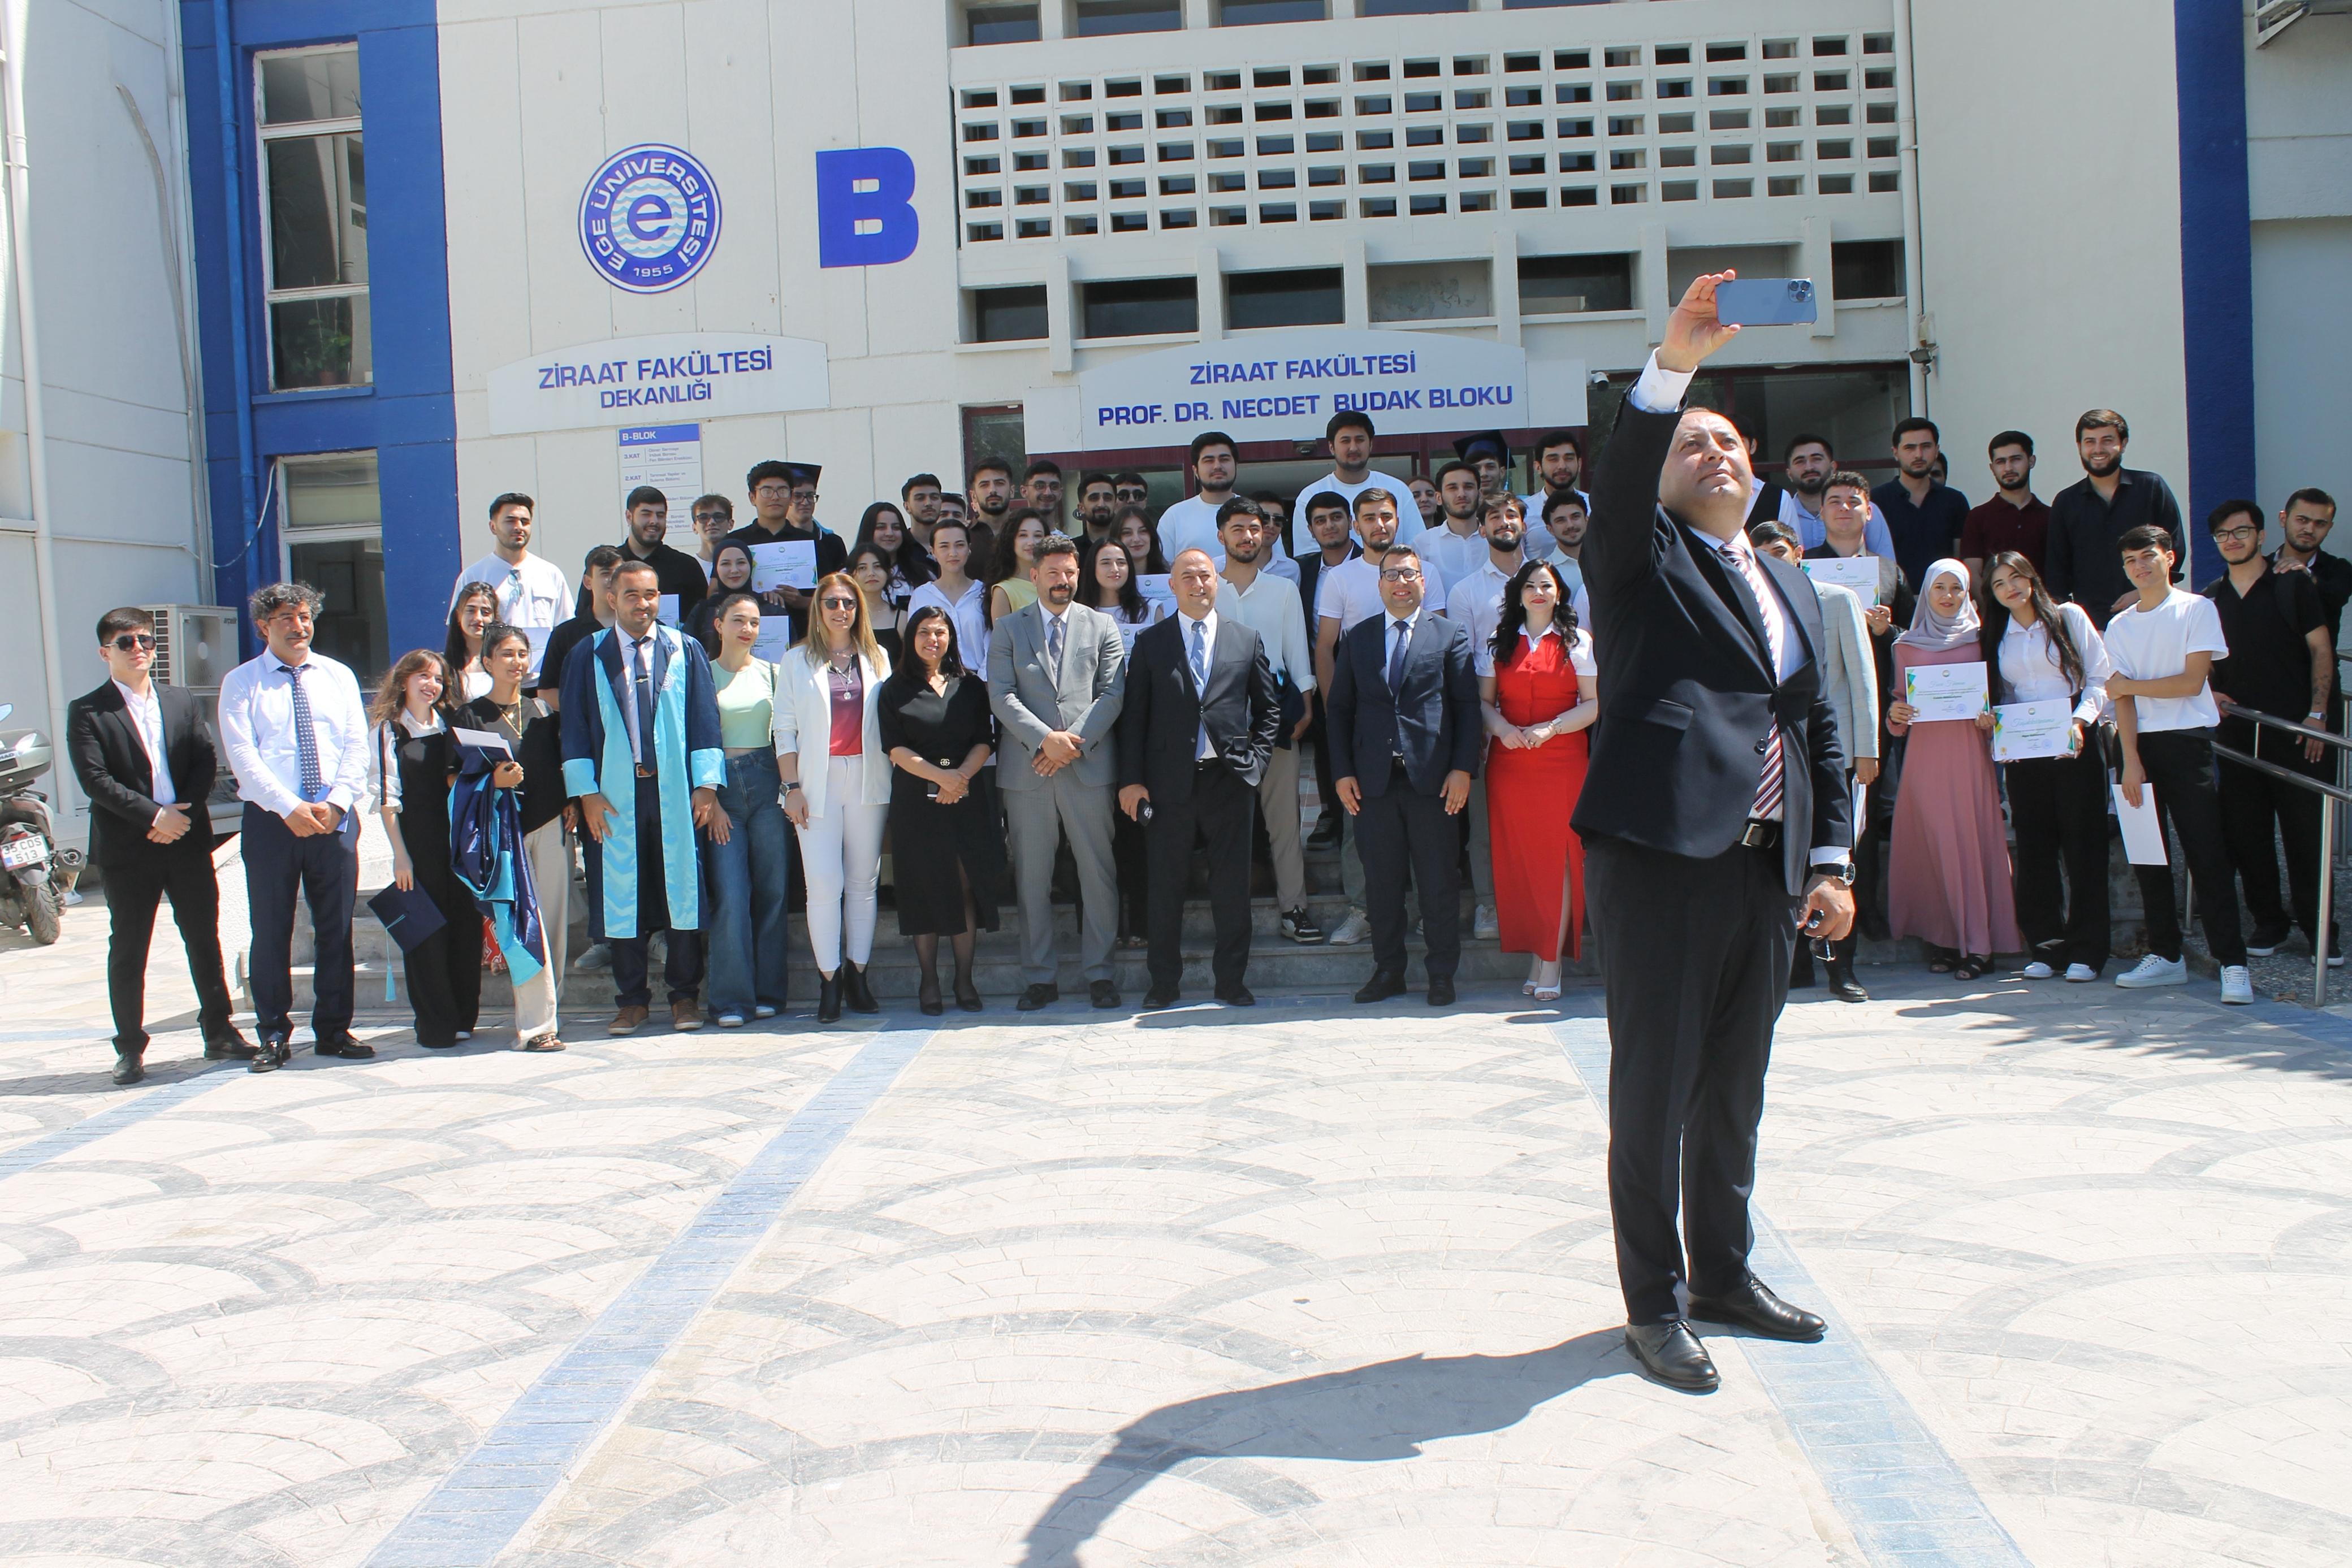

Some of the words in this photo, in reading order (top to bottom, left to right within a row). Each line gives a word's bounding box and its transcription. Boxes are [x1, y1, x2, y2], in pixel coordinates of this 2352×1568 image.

[591, 158, 708, 267] ÜNİVERSİTESİ
[816, 148, 919, 268] B
[592, 218, 627, 271] EGE
[633, 263, 673, 278] 1955
[538, 362, 628, 389] ZİRAAT
[638, 345, 773, 381] FAKÜLTESİ
[1190, 360, 1278, 385] ZİRAAT
[1286, 350, 1416, 379] FAKÜLTESİ
[600, 379, 712, 409] DEKANLIĞI
[1099, 404, 1167, 426] PROF.
[1174, 401, 1214, 422] DR.
[1222, 395, 1320, 419] NECDET
[1334, 389, 1422, 413] BUDAK
[1429, 385, 1513, 409] BLOKU
[622, 431, 657, 441] B-BLOK
[2, 843, 18, 854] 35
[20, 837, 42, 850] CDS
[16, 850, 38, 863] 513
